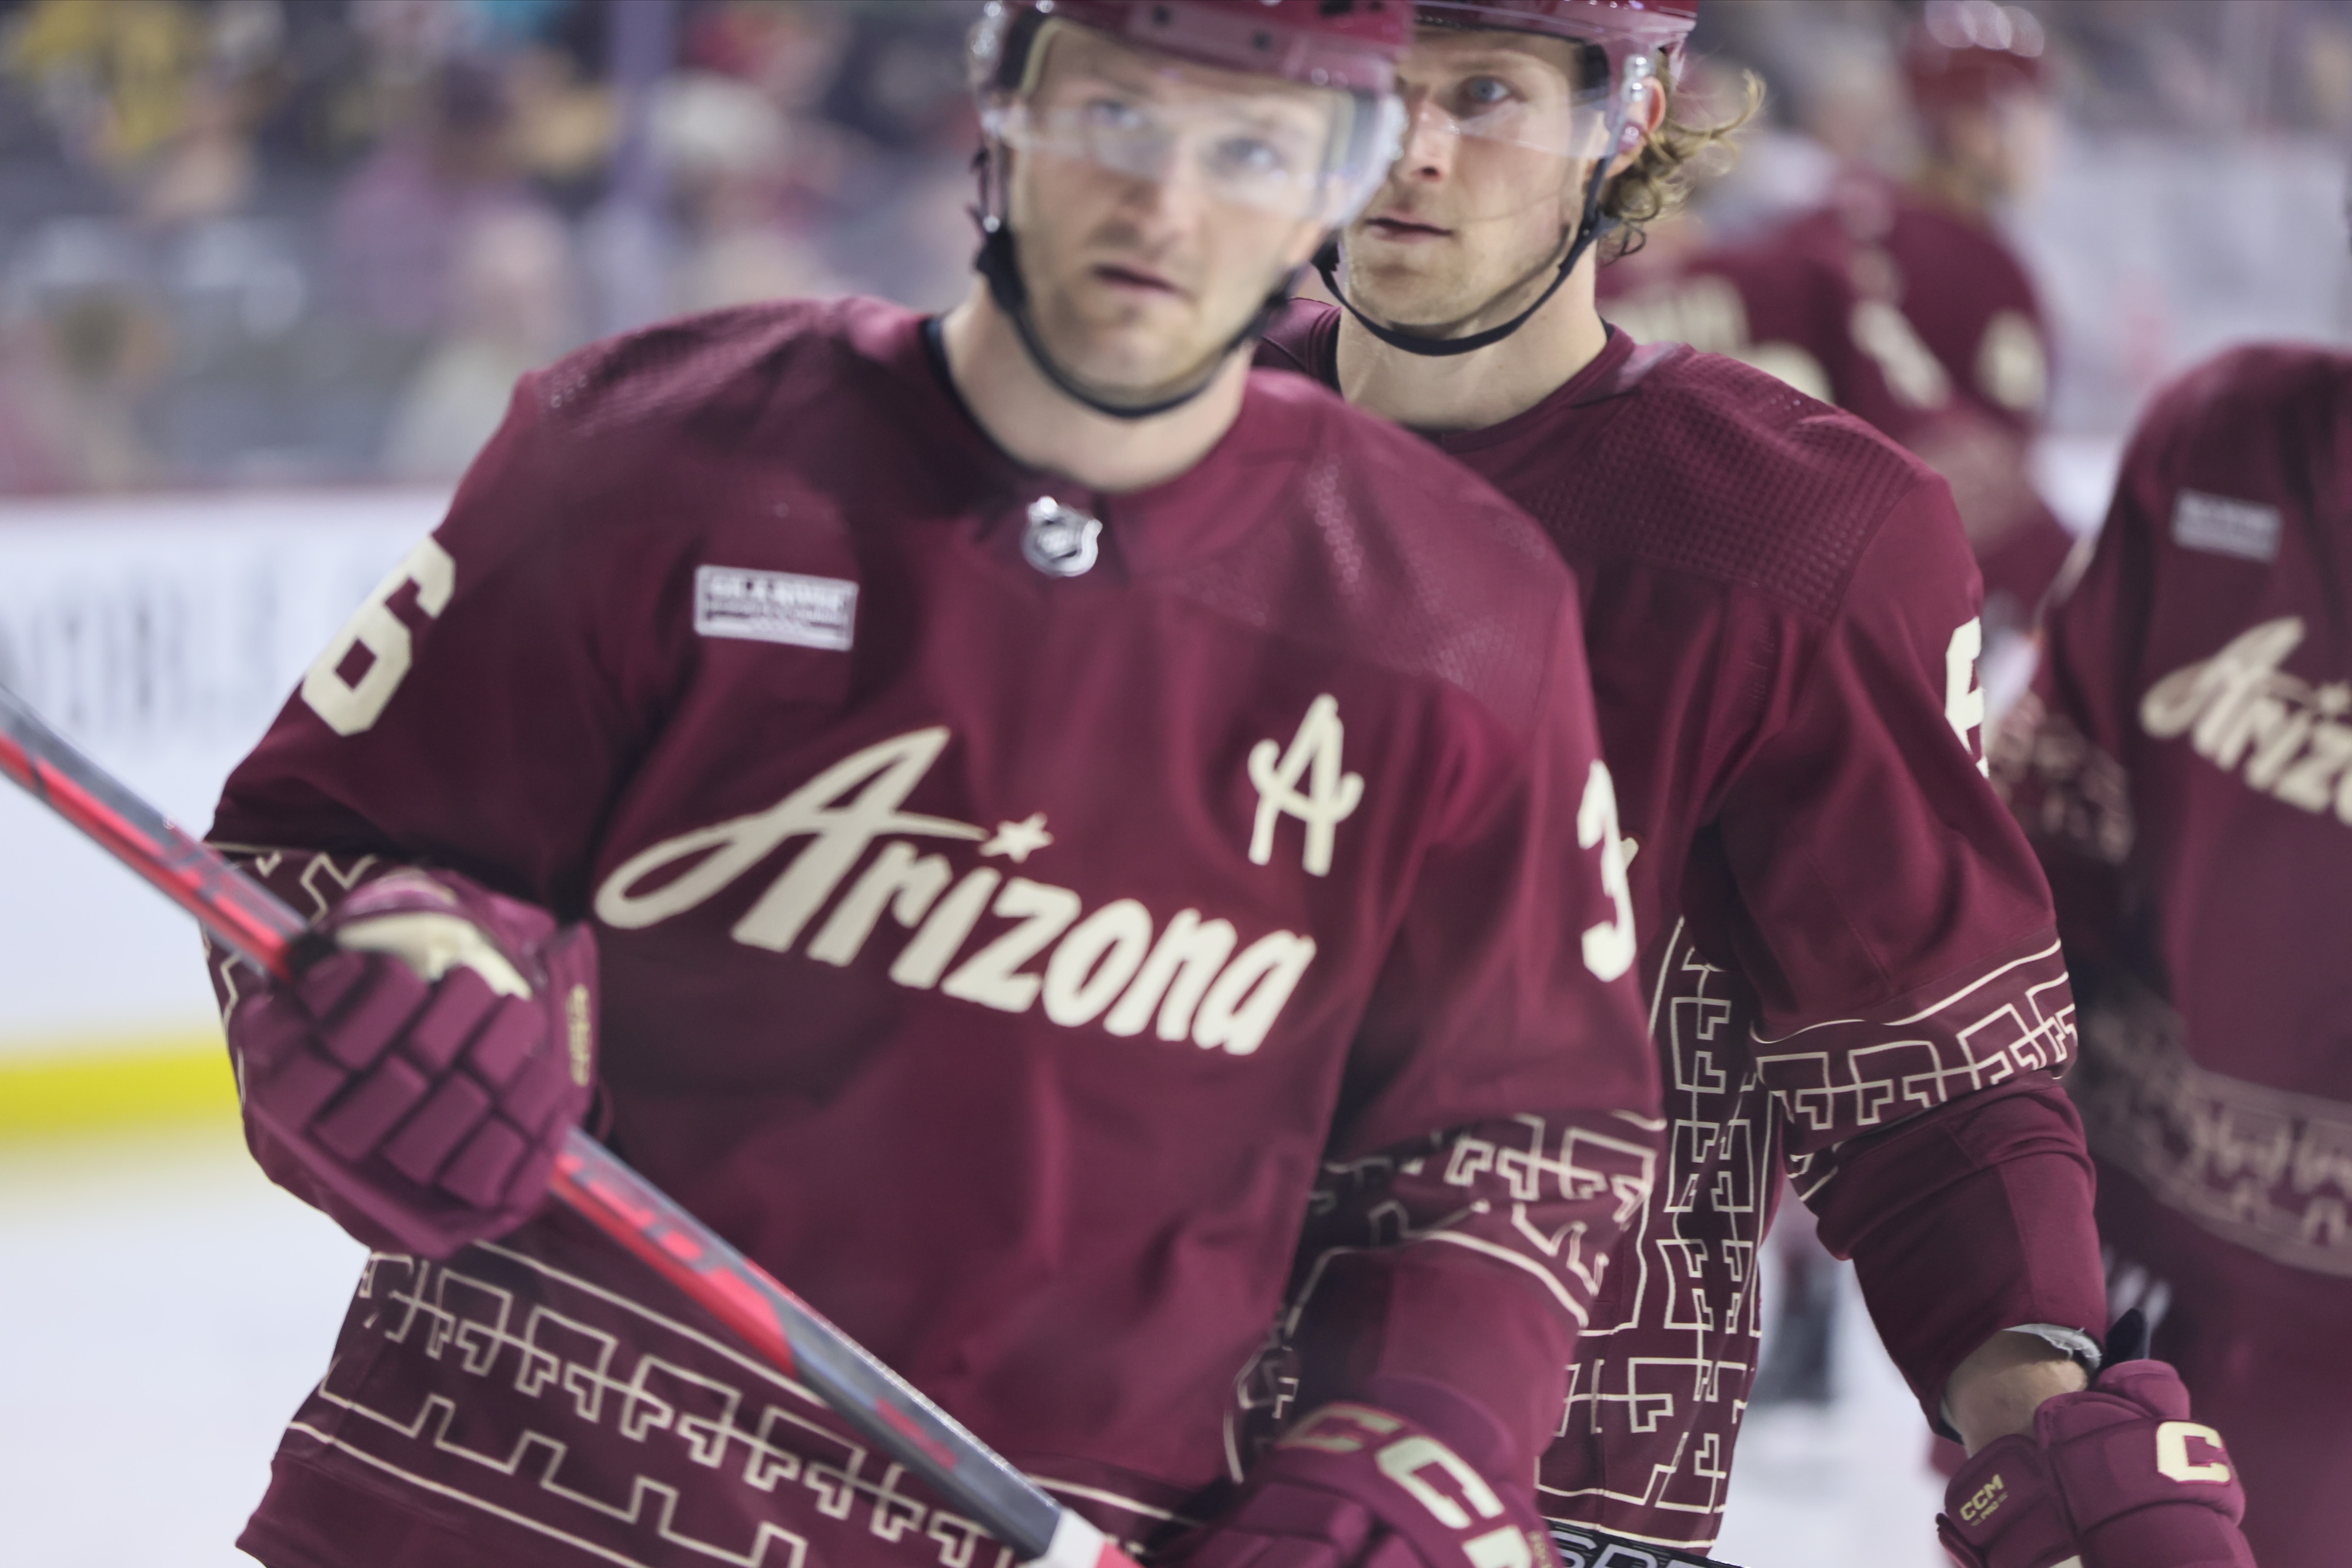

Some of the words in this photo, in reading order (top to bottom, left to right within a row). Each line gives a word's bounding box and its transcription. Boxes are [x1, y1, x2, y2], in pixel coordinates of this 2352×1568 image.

[1249, 695, 1364, 876] A
[1576, 759, 1636, 982] 3
[594, 725, 1317, 1056] Arizona
[1960, 1474, 2004, 1521] CCM
